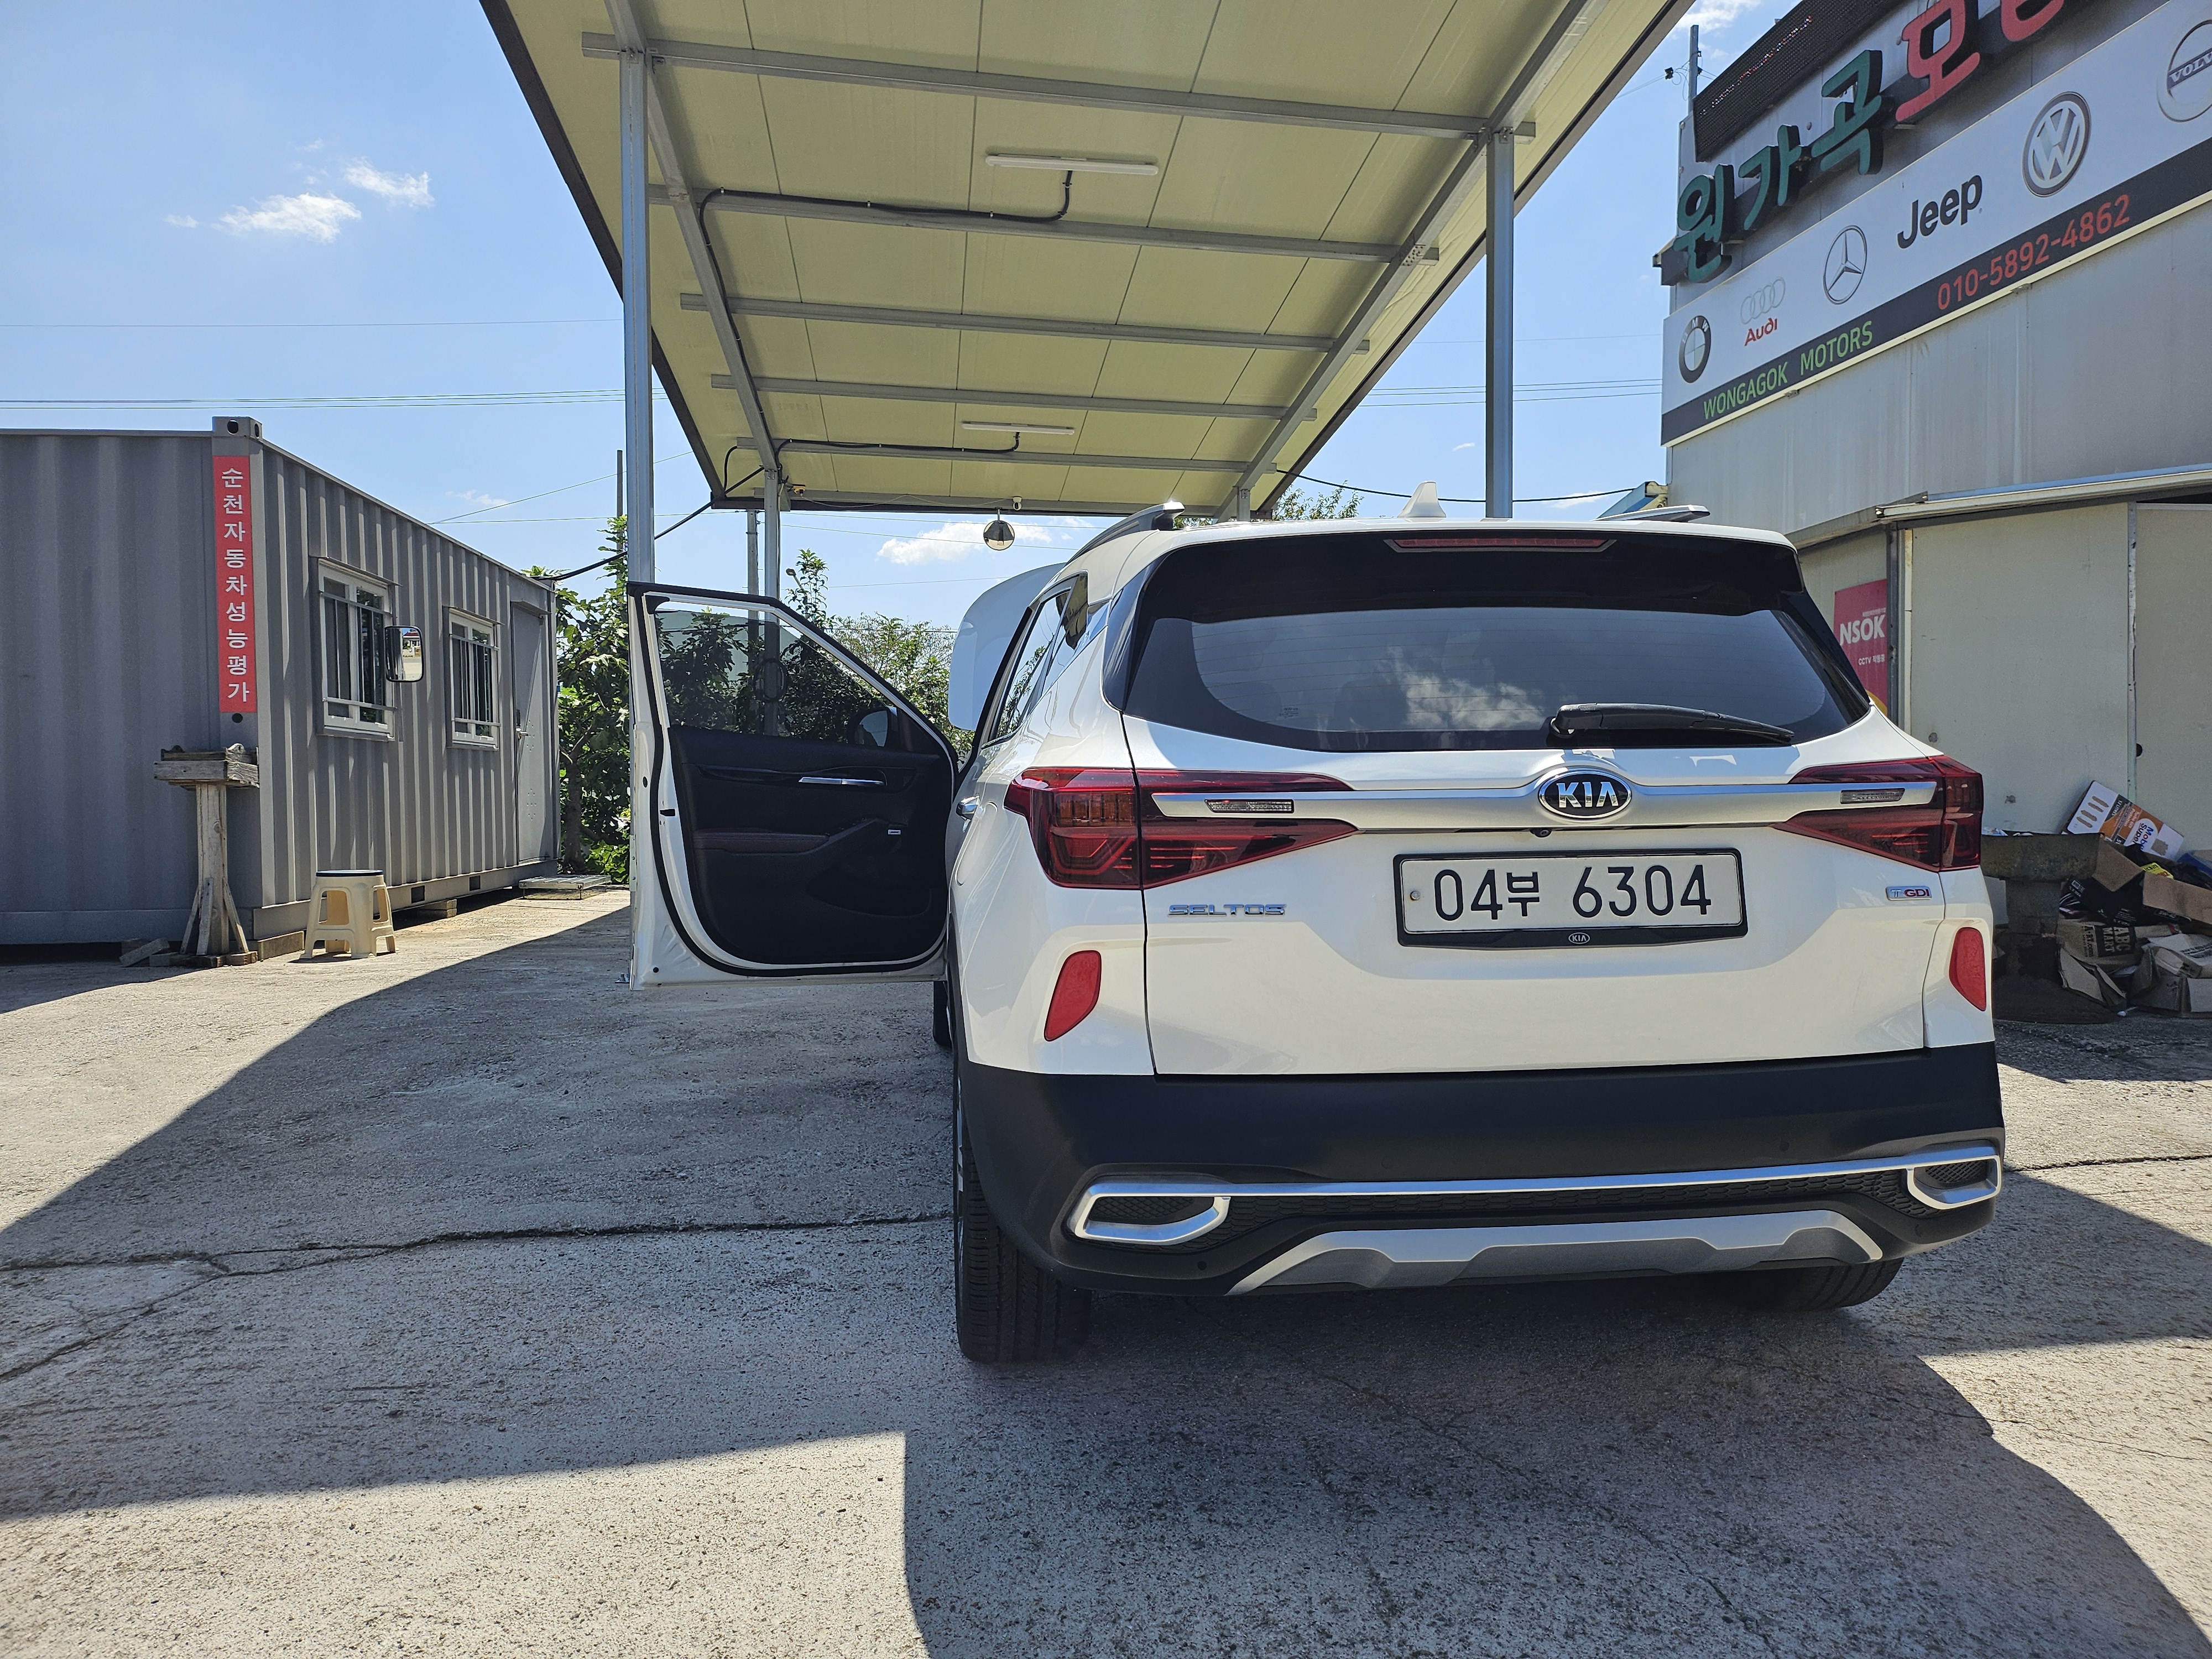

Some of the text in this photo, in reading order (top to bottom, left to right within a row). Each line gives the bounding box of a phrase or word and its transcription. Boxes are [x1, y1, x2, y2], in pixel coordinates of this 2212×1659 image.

[2169, 51, 2212, 82] VOLV
[1673, 50, 1881, 282] 원가곡
[1897, 175, 1983, 249] Jeep
[1938, 194, 2130, 310] 010-5892-4862
[1744, 317, 1778, 347] Audi
[1703, 320, 1873, 420] WONGAGOK MOTORS
[222, 467, 250, 703] 순천자동차성능평가
[1840, 614, 1885, 646] NSOK
[1858, 656, 1872, 665] CCTV
[1557, 781, 1619, 808] KIA
[1434, 864, 1712, 921] 04부 6304
[1167, 904, 1287, 916] SELTOS
[2103, 927, 2115, 952] MART
[2114, 926, 2131, 951] ABC
